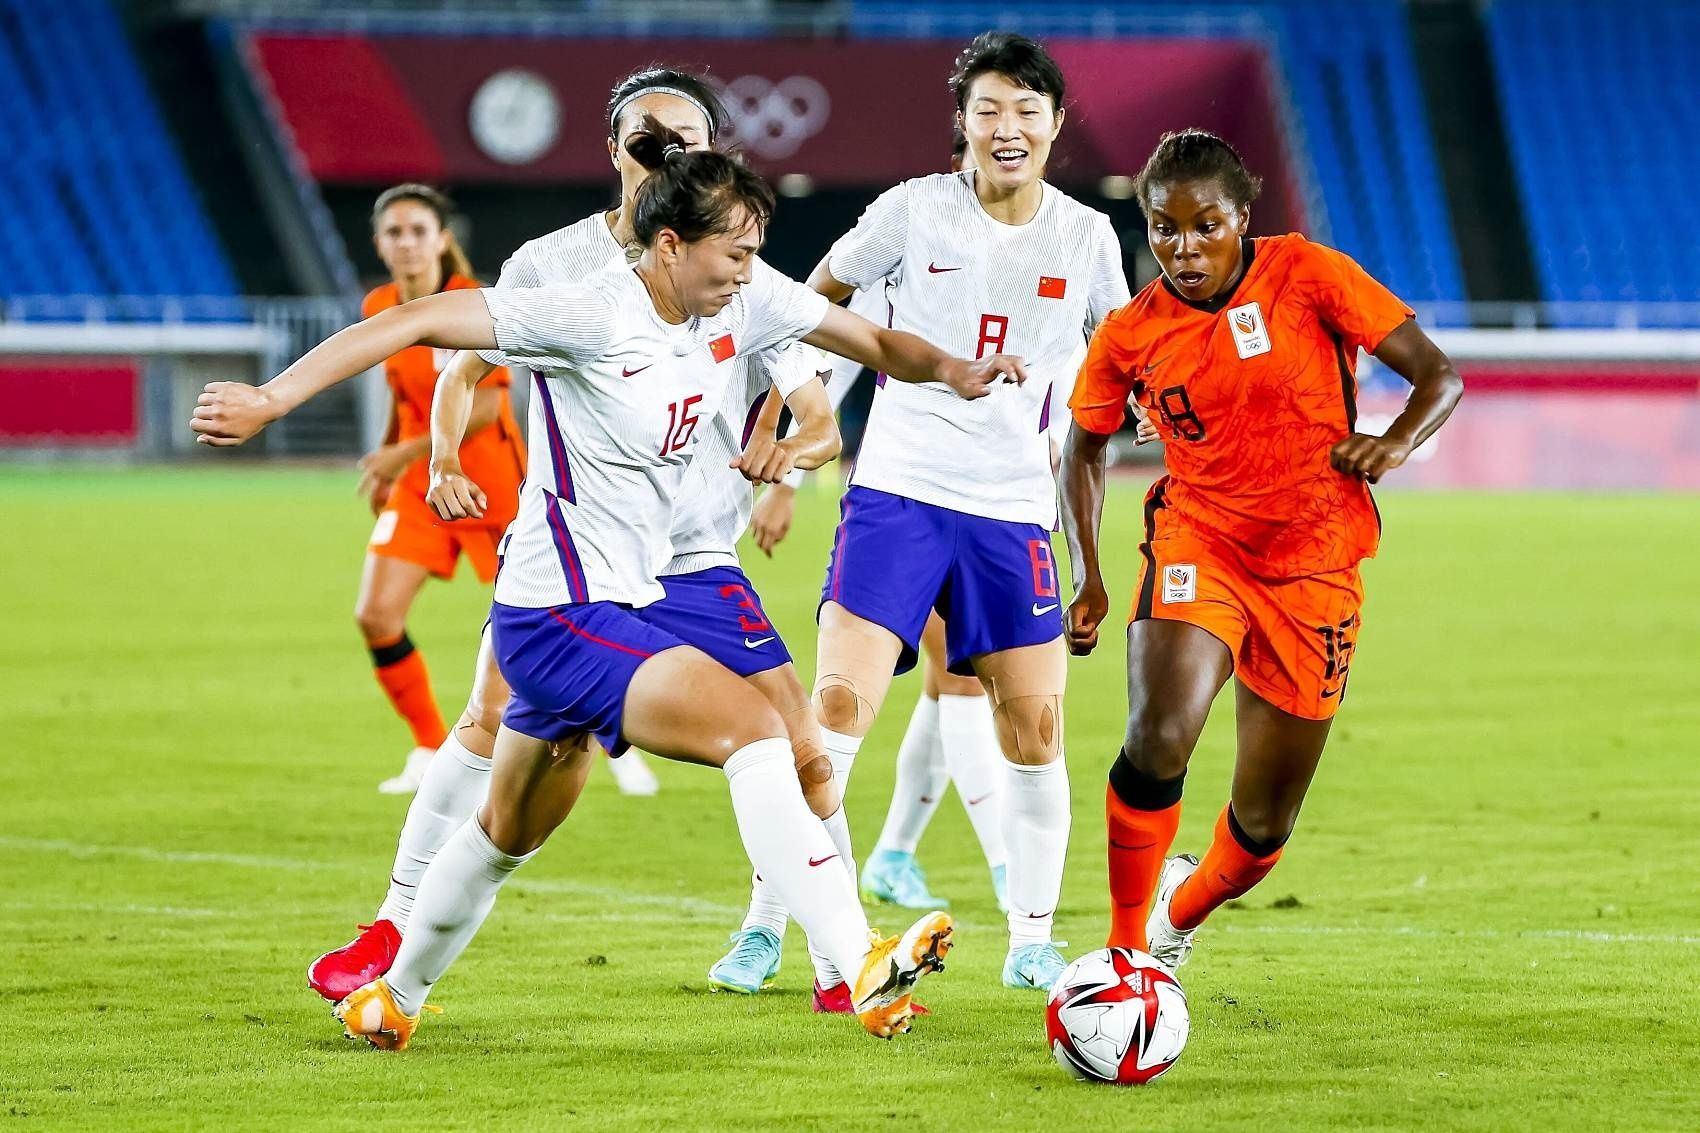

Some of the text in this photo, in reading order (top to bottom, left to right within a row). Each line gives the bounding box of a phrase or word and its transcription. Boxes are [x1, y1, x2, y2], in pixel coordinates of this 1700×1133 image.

[976, 314, 1008, 360] 8
[658, 394, 703, 457] 16
[1028, 540, 1057, 598] 8
[718, 584, 768, 632] 3
